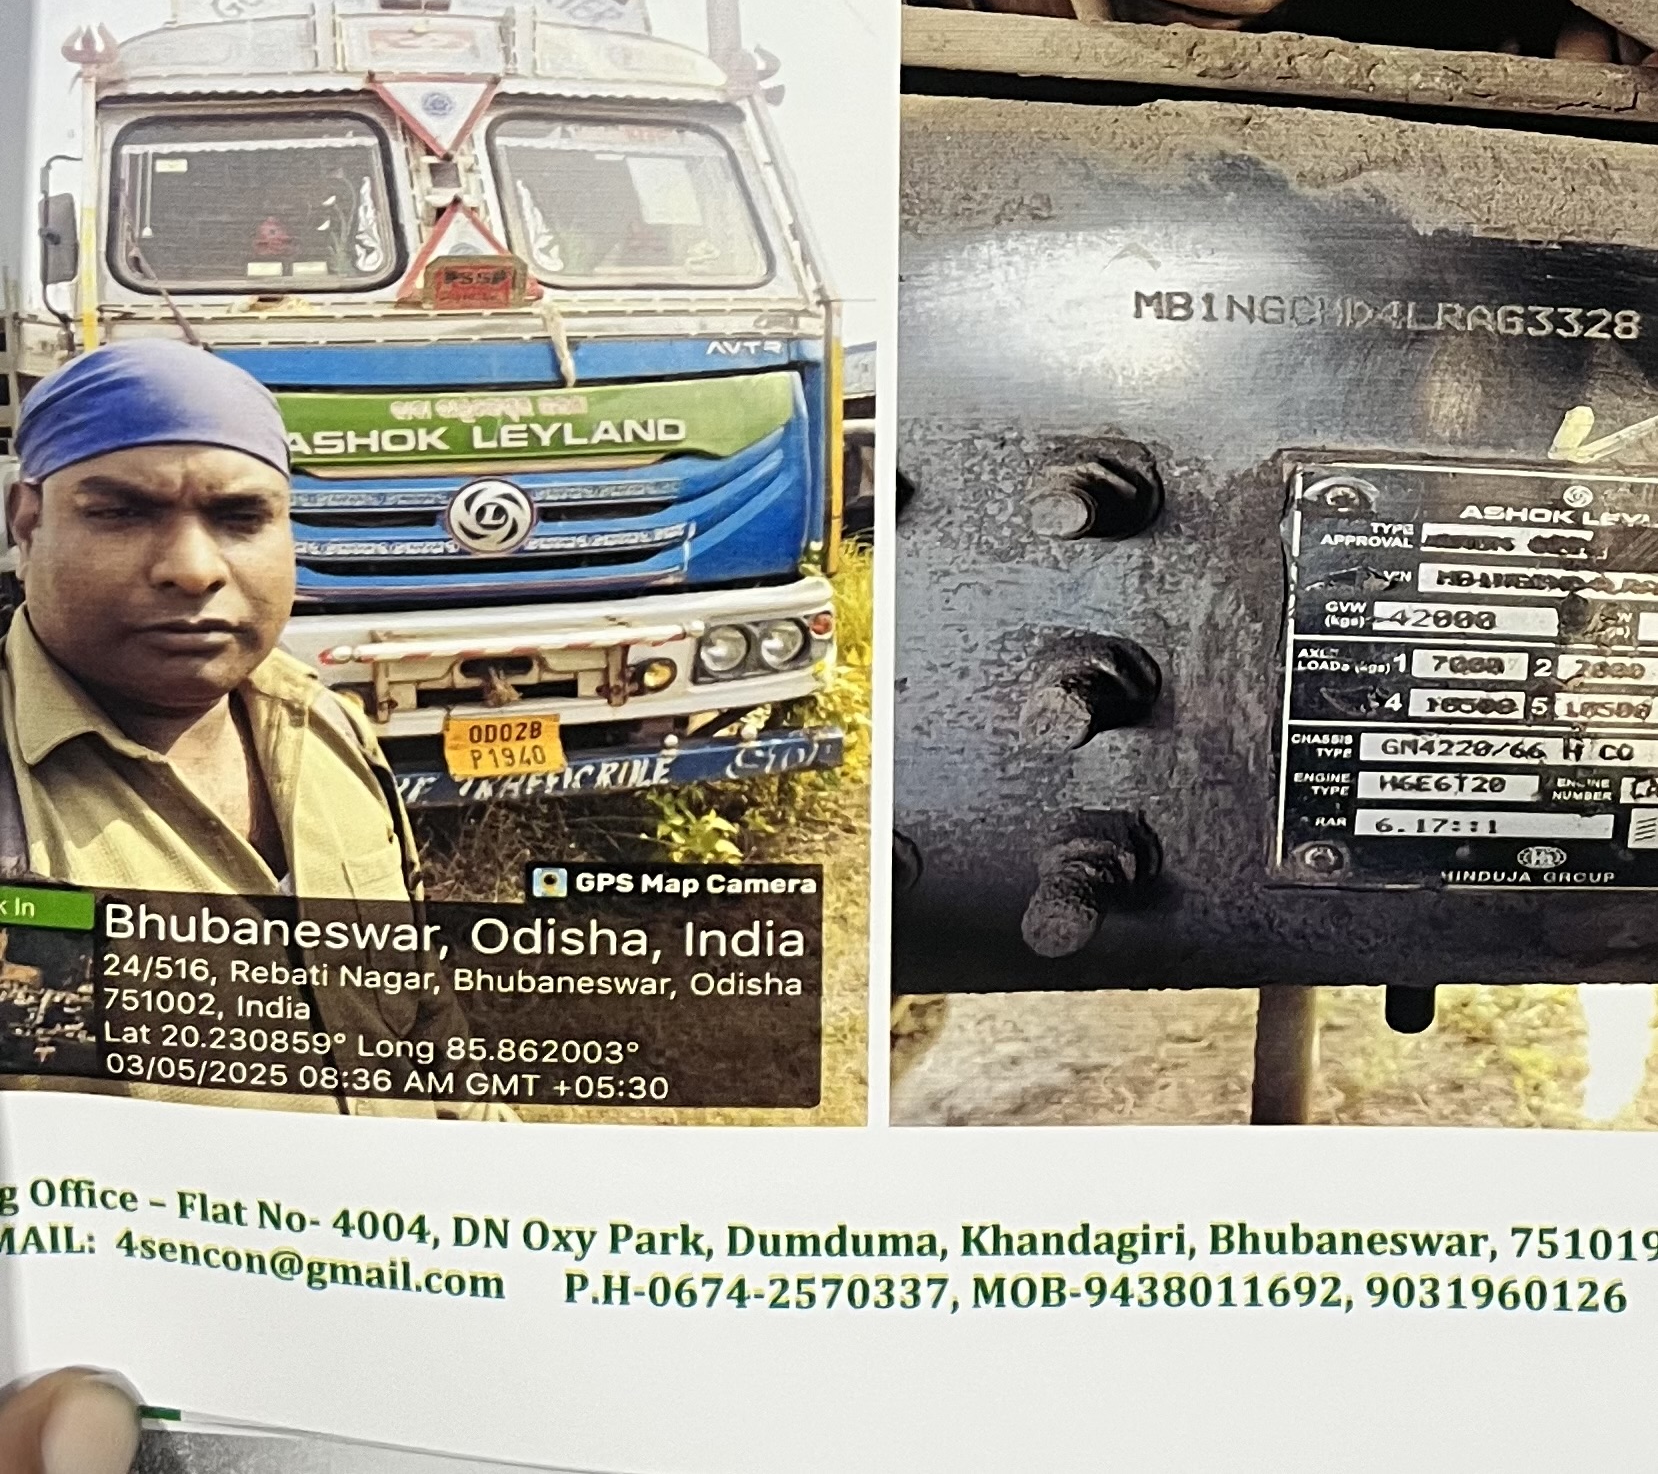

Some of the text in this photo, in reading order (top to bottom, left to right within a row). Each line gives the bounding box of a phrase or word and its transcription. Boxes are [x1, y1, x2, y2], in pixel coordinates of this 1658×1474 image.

[705, 339, 782, 356] AVTR
[286, 418, 686, 456] ASHOK LEYLAND
[1460, 505, 1576, 524] ASHOK
[1371, 522, 1413, 536] TYPE
[1321, 533, 1413, 549] APPROVAL
[1325, 601, 1367, 614] GVW
[1390, 608, 1497, 630] 42000
[1393, 653, 1407, 673] 1
[1533, 658, 1552, 677] 2
[1384, 692, 1403, 712] 4
[1530, 696, 1549, 715] 5
[469, 720, 542, 743] OD02B
[1291, 733, 1353, 745] CHASSIS
[470, 744, 546, 770] P1940
[1316, 747, 1352, 759] TYPE
[1293, 772, 1350, 784] ENGINE
[1311, 785, 1349, 796] TYPE
[1552, 791, 1612, 801] NUMBER
[1442, 870, 1615, 884] HINDUJA GROUP
[30, 1178, 139, 1212] Office
[177, 1190, 248, 1226] Flat
[258, 1200, 321, 1232] No-
[332, 1209, 440, 1250] 4004,
[453, 1215, 509, 1248] DN
[523, 1220, 598, 1261] Oxy
[609, 1221, 714, 1262] Park,
[727, 1223, 949, 1262] Dumduma,
[961, 1223, 1197, 1265] Khandagiri,
[1209, 1222, 1498, 1263] Bhubaneswar,
[1510, 1227, 1658, 1262] 751019
[116, 1229, 506, 1300] 4sencon@gmail.com
[564, 1273, 960, 1315] P.H-0674-2570337,
[972, 1275, 1354, 1314] MOB-9438011692,
[1366, 1275, 1628, 1313] 9031960126
